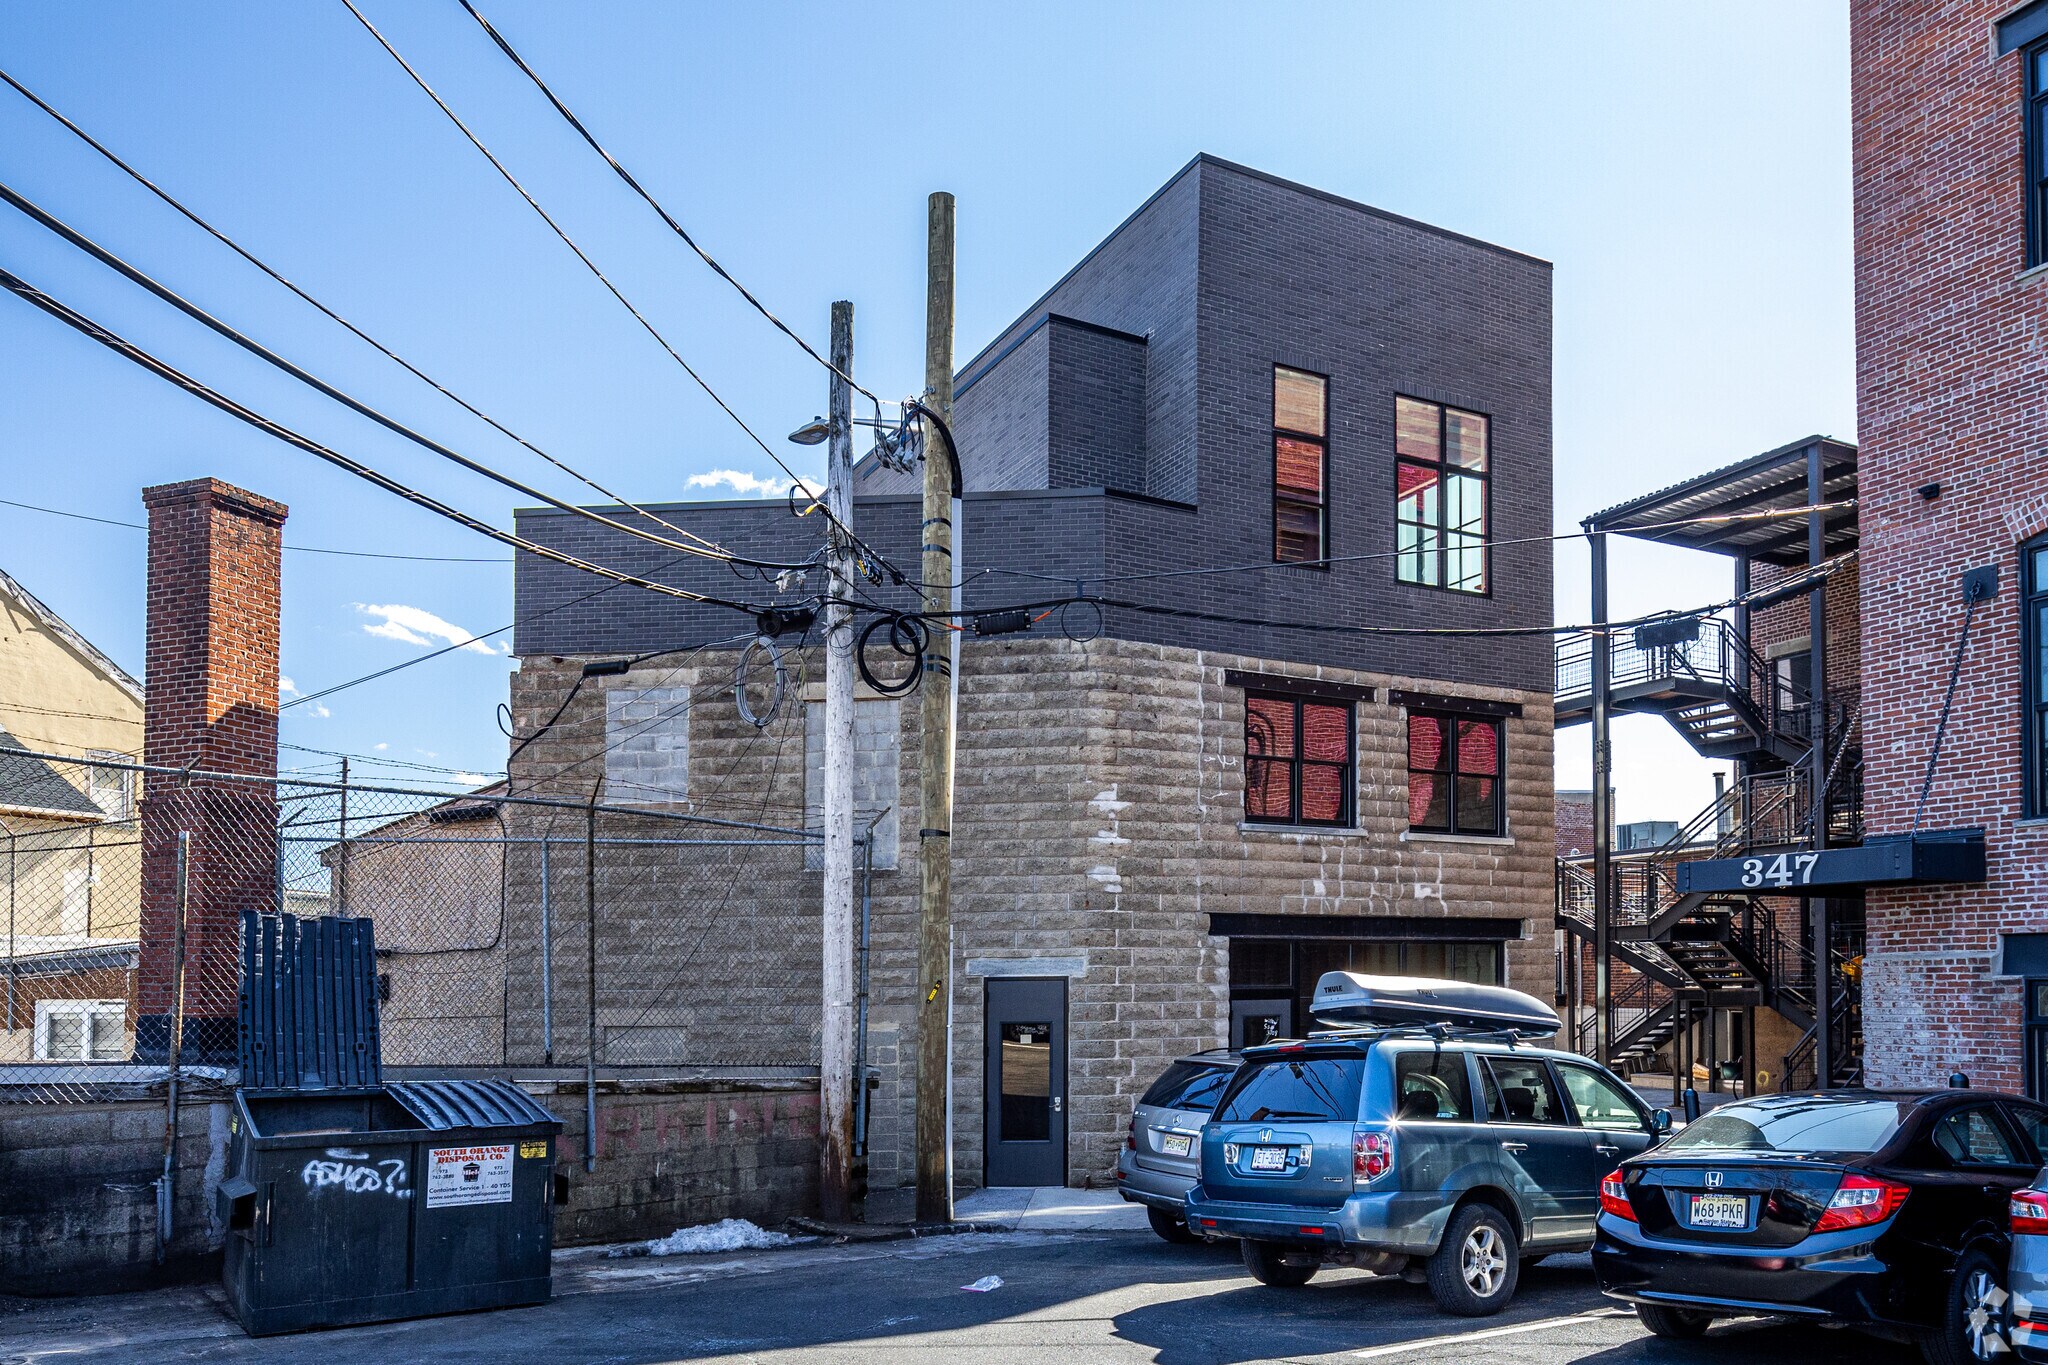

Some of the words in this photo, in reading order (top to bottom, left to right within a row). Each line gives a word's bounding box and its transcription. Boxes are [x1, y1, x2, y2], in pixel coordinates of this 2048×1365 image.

[1741, 854, 1819, 887] 347
[1324, 985, 1343, 993] THULE
[469, 1146, 510, 1154] ORANGE
[437, 1154, 488, 1164] DISPOSAL
[1694, 1202, 1715, 1218] W68
[1721, 1203, 1743, 1219] PKR
